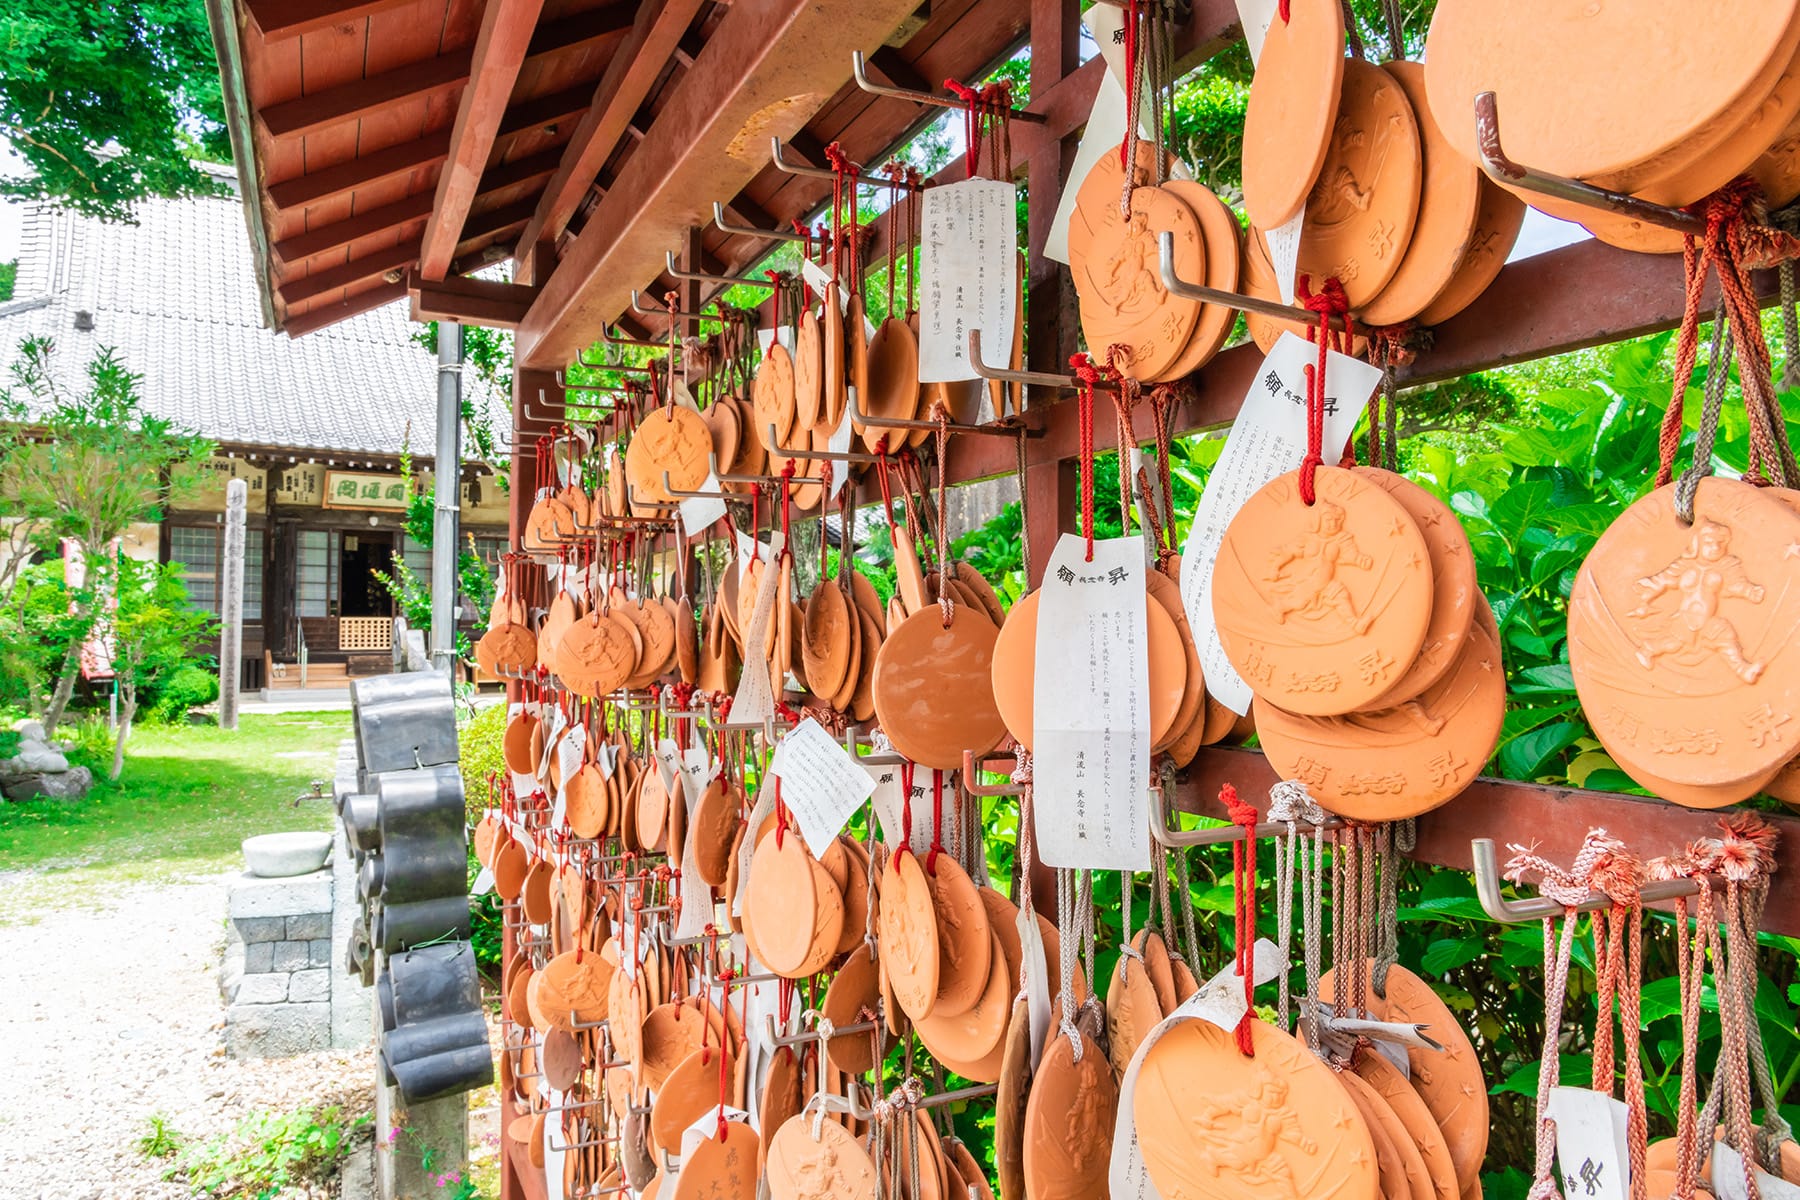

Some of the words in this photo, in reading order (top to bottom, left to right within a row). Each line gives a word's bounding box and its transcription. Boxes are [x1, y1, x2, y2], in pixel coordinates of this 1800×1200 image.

[1265, 369, 1284, 397] 願
[1056, 564, 1077, 587] 願
[1108, 566, 1130, 587] 昇
[1076, 751, 1086, 779] 清流山
[1425, 750, 1470, 788] 昇
[1077, 789, 1087, 818] 長念寺
[1077, 823, 1088, 840] 住職
